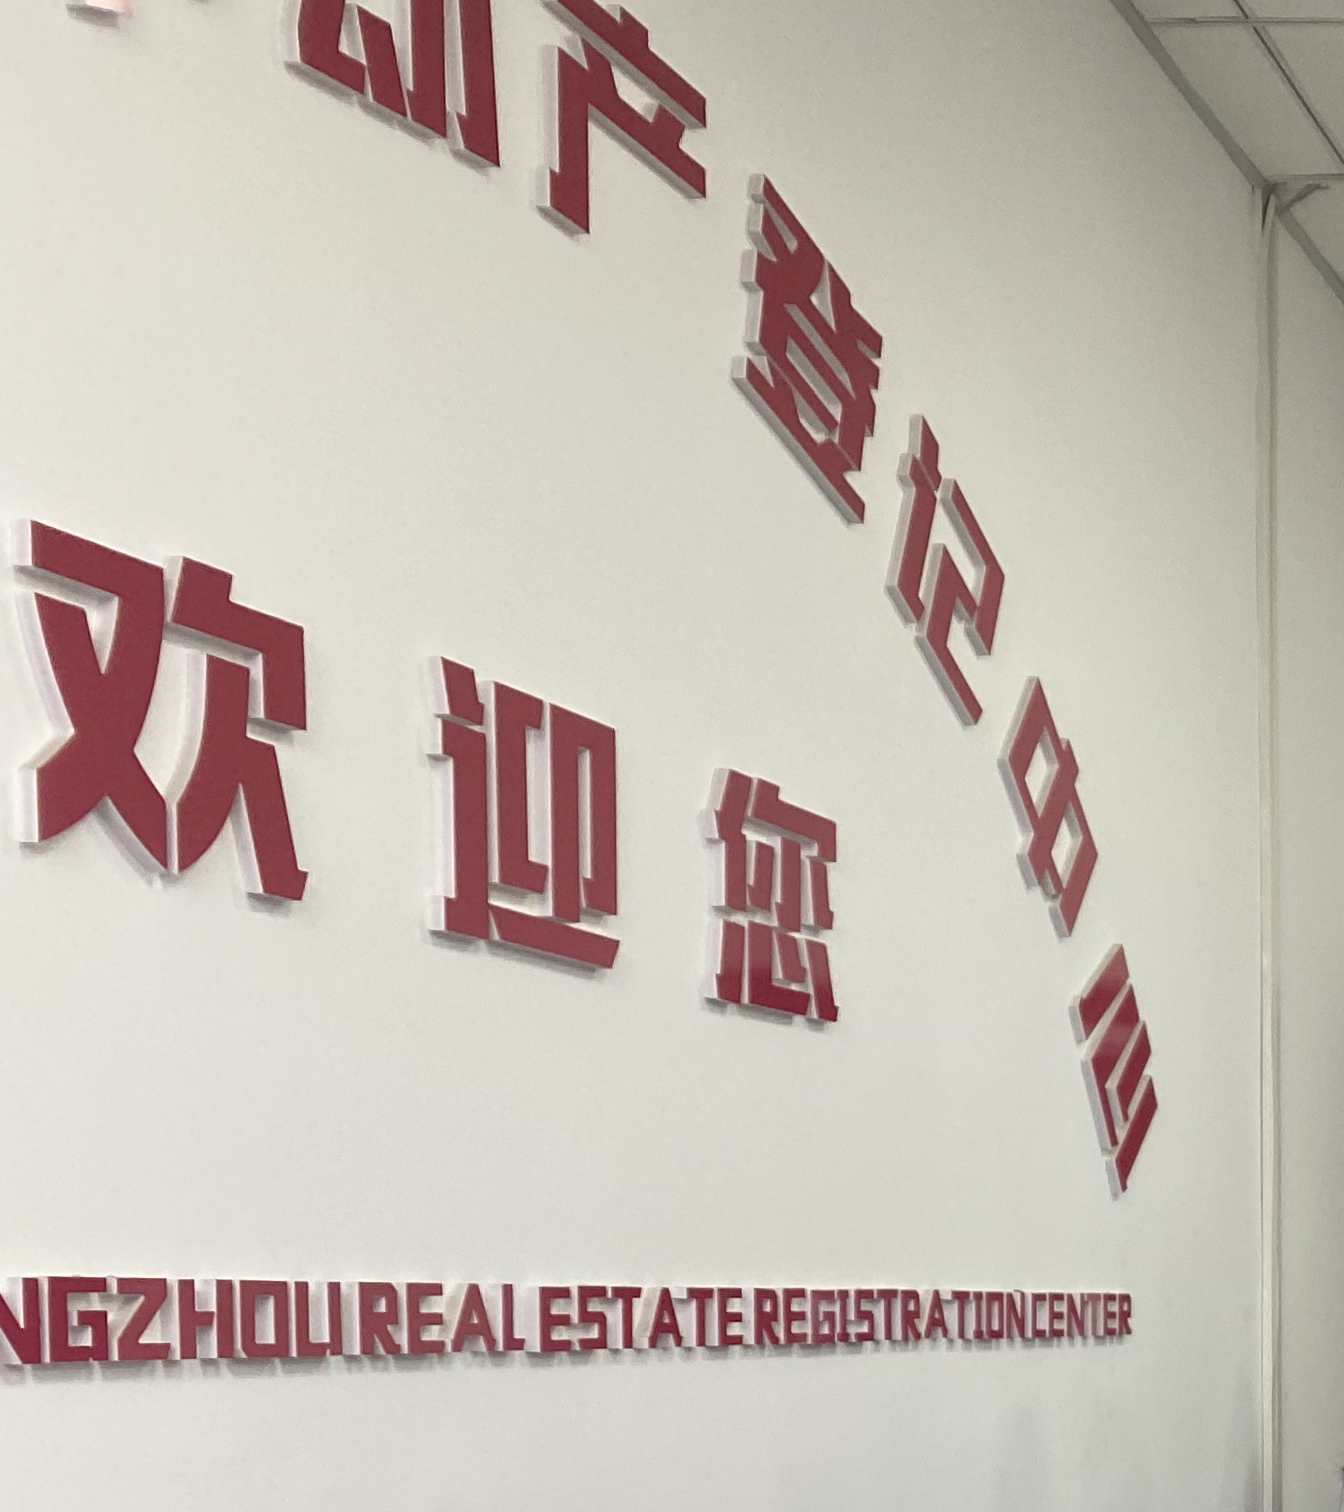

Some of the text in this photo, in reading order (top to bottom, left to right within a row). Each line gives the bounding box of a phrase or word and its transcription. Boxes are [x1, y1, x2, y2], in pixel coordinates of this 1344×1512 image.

[20, 518, 838, 1023] 欢迎您
[355, 1280, 526, 1355] REAL
[536, 1284, 745, 1352] ESTATE
[751, 1286, 1026, 1345] REGISTRATION
[1030, 1289, 1133, 1339] CENTER
